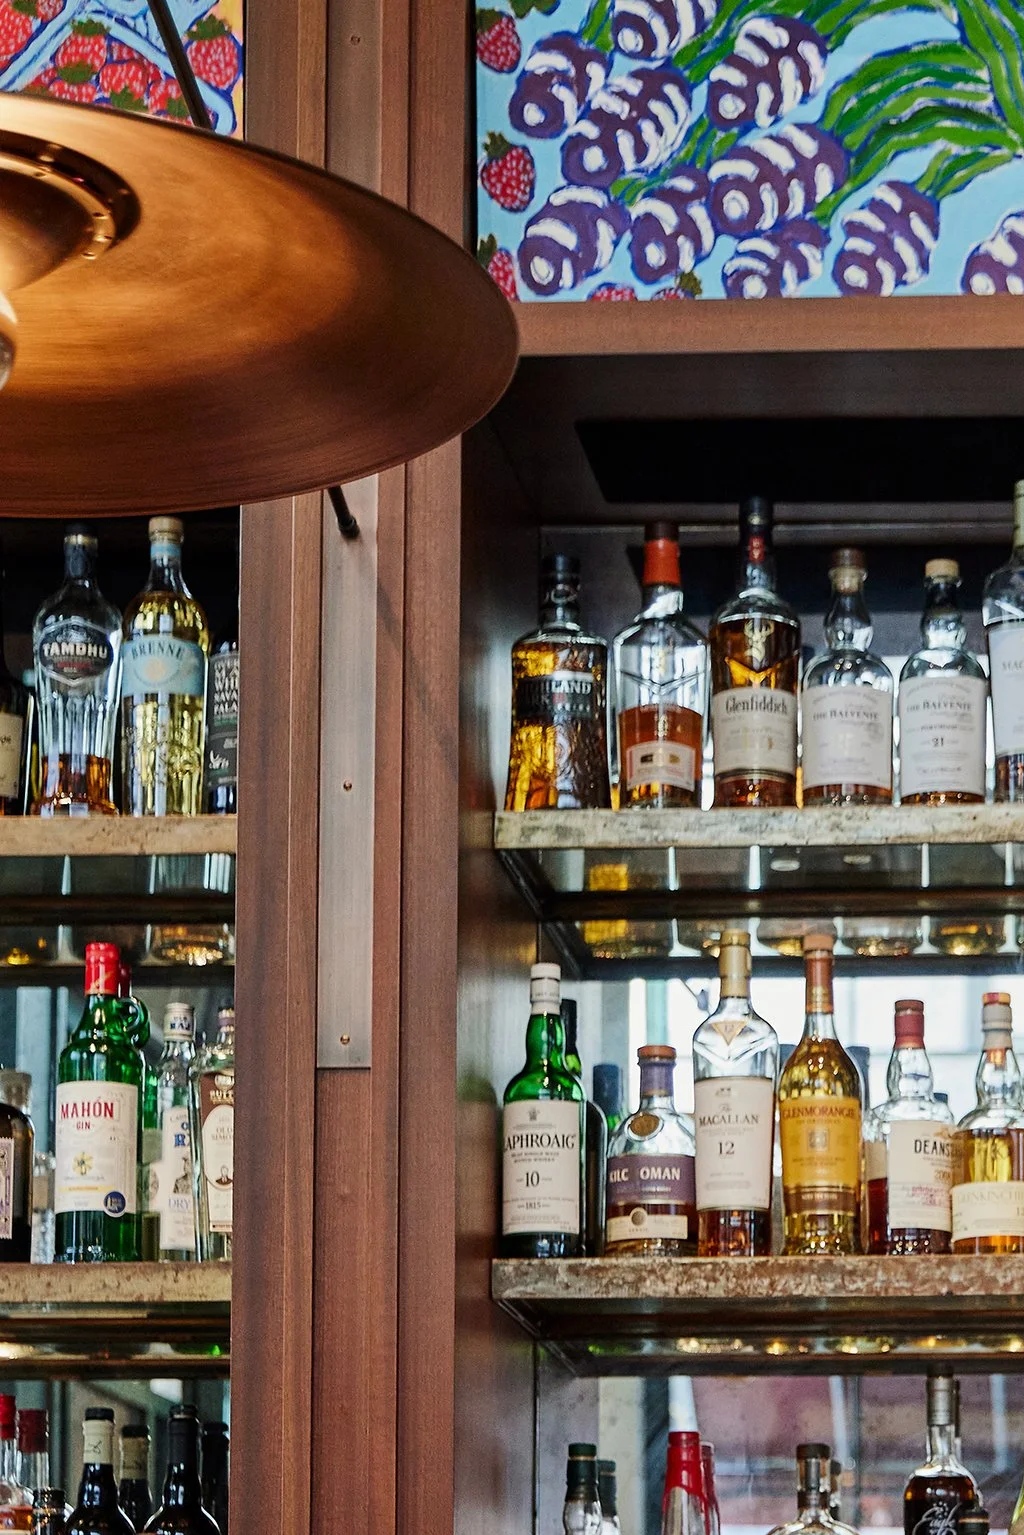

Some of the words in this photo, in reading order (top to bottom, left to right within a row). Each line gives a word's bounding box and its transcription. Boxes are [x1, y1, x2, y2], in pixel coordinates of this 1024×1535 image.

[42, 643, 108, 659] TAMDHU
[131, 642, 185, 659] BRENNE
[725, 695, 788, 715] Glenfiddich
[931, 736, 945, 748] 21
[61, 1097, 115, 1120] MAHÓN
[76, 1121, 92, 1131] GIN
[698, 1112, 760, 1126] MACALLAN
[502, 1133, 576, 1151] APHROAIG
[718, 1141, 736, 1156] 12
[525, 1171, 540, 1188] 10
[609, 1166, 681, 1183] KILCOMAN
[168, 1198, 190, 1211] DRY
[525, 1201, 542, 1210] 1815
